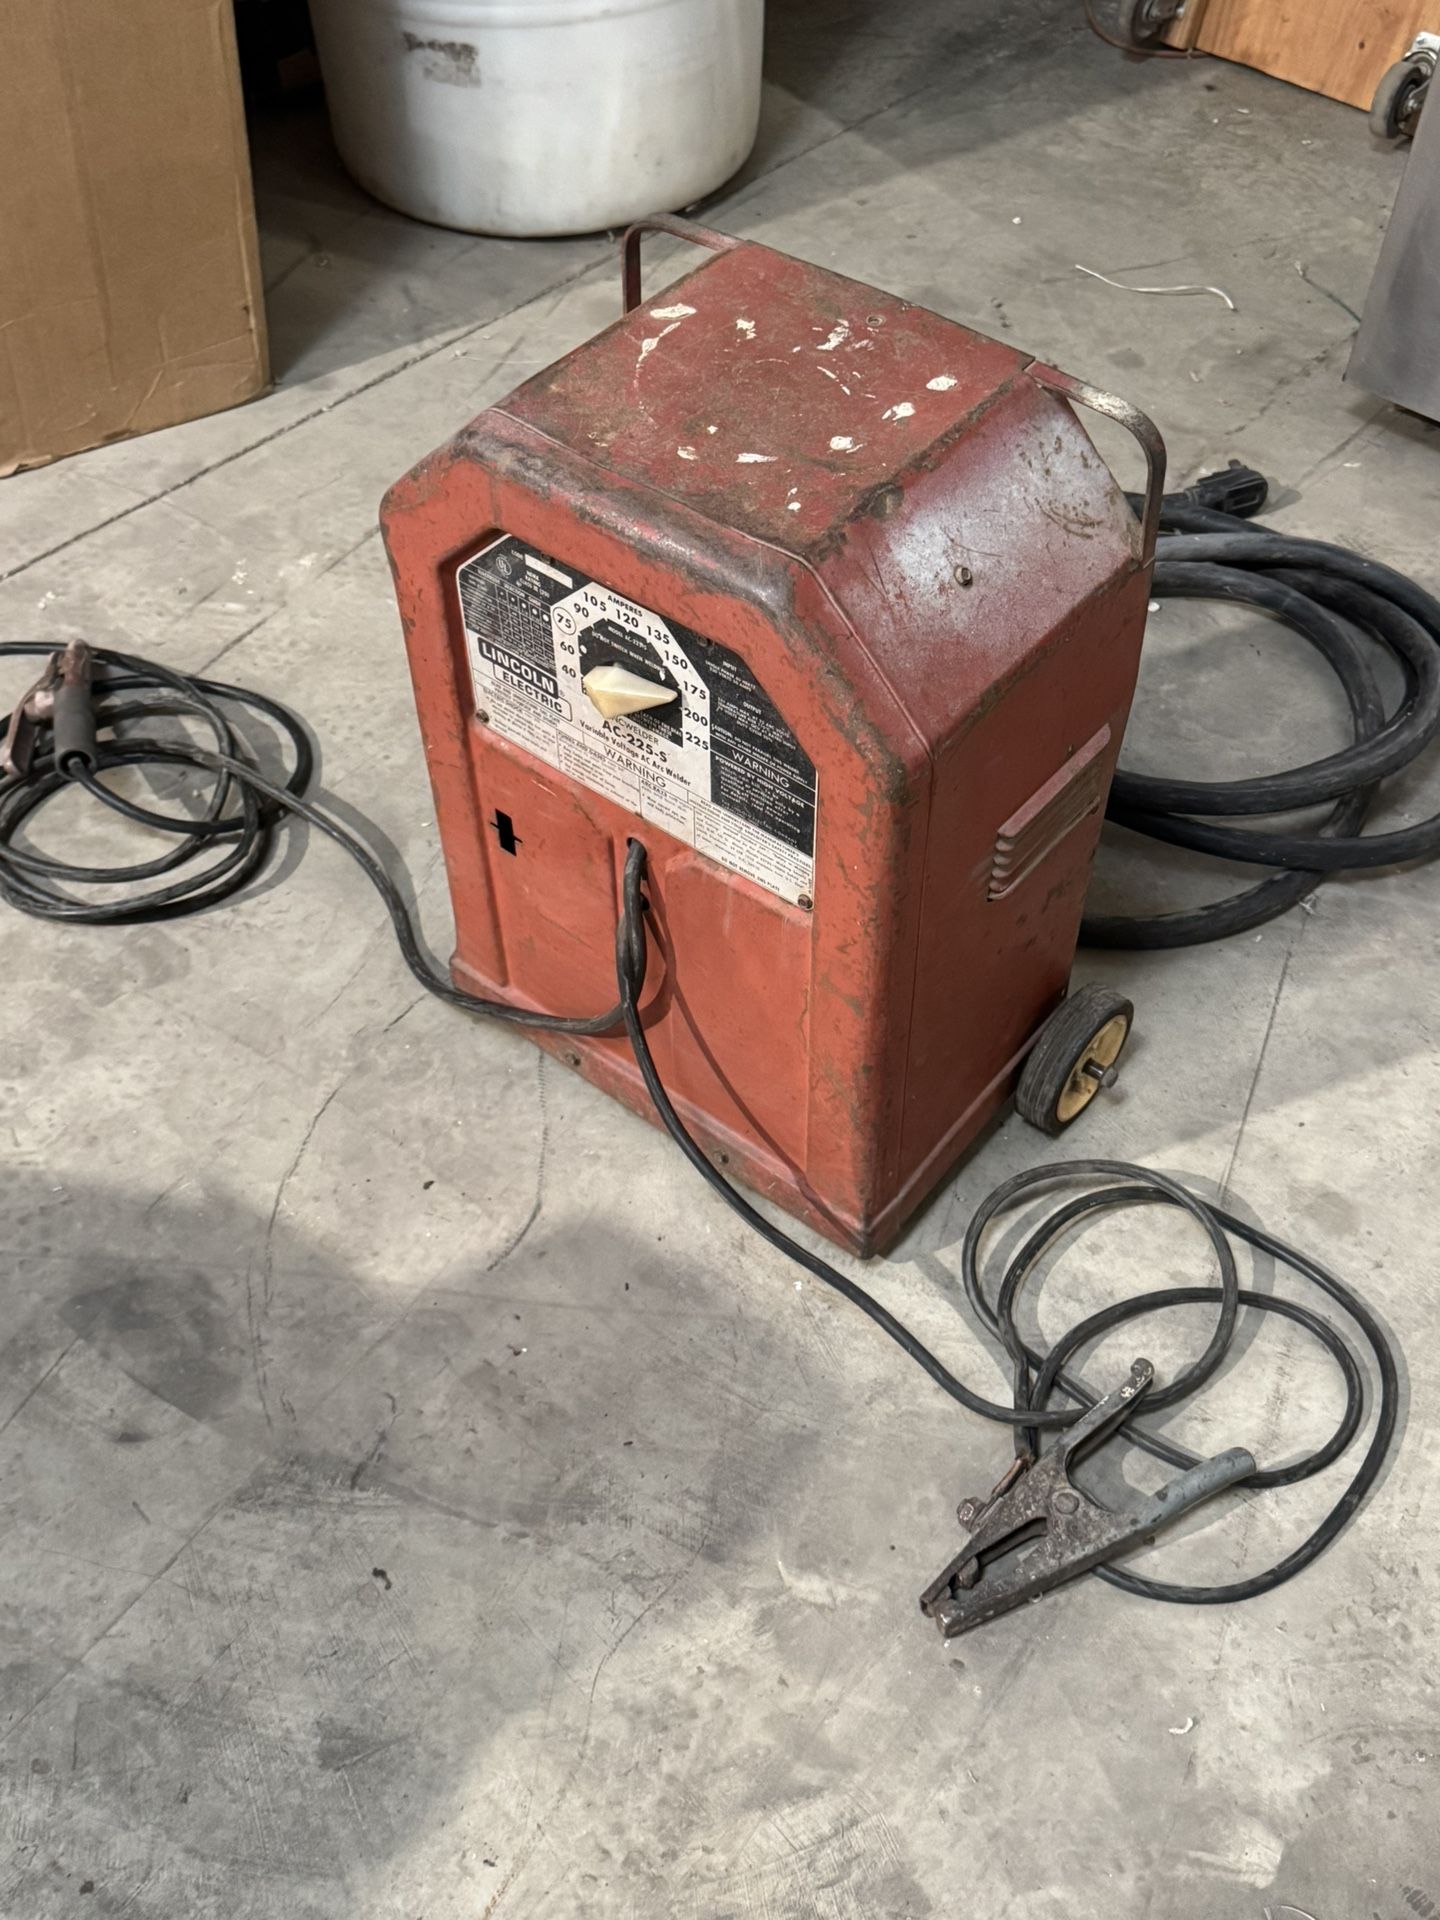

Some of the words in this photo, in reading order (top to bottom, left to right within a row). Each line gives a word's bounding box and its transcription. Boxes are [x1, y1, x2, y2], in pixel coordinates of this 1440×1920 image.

[573, 602, 589, 618] 90
[583, 591, 606, 612] 105
[607, 594, 642, 617] AMPERES
[556, 613, 571, 629] 75
[616, 608, 638, 628] 120
[647, 625, 669, 645] 135
[559, 640, 574, 655] 60
[481, 642, 554, 694] LINCOLN
[665, 650, 687, 670] 150
[561, 663, 576, 679] 40
[502, 670, 562, 713] ELECTRIC
[683, 680, 706, 700] 175
[684, 707, 707, 727] 200
[743, 701, 761, 715] OUTPUT
[602, 718, 667, 764] AC-225-S
[685, 730, 708, 751] 225
[580, 719, 609, 741] Variable
[611, 736, 638, 759] Voltage
[641, 753, 650, 764] AC
[652, 759, 663, 772] Arc
[666, 767, 691, 787] Welder
[603, 745, 666, 789] WARNING
[731, 748, 789, 789] WARNING
[715, 755, 745, 775] POWERED
[747, 772, 754, 780] BY
[757, 777, 773, 790] HIGH
[775, 787, 804, 808] VOLTAGE
